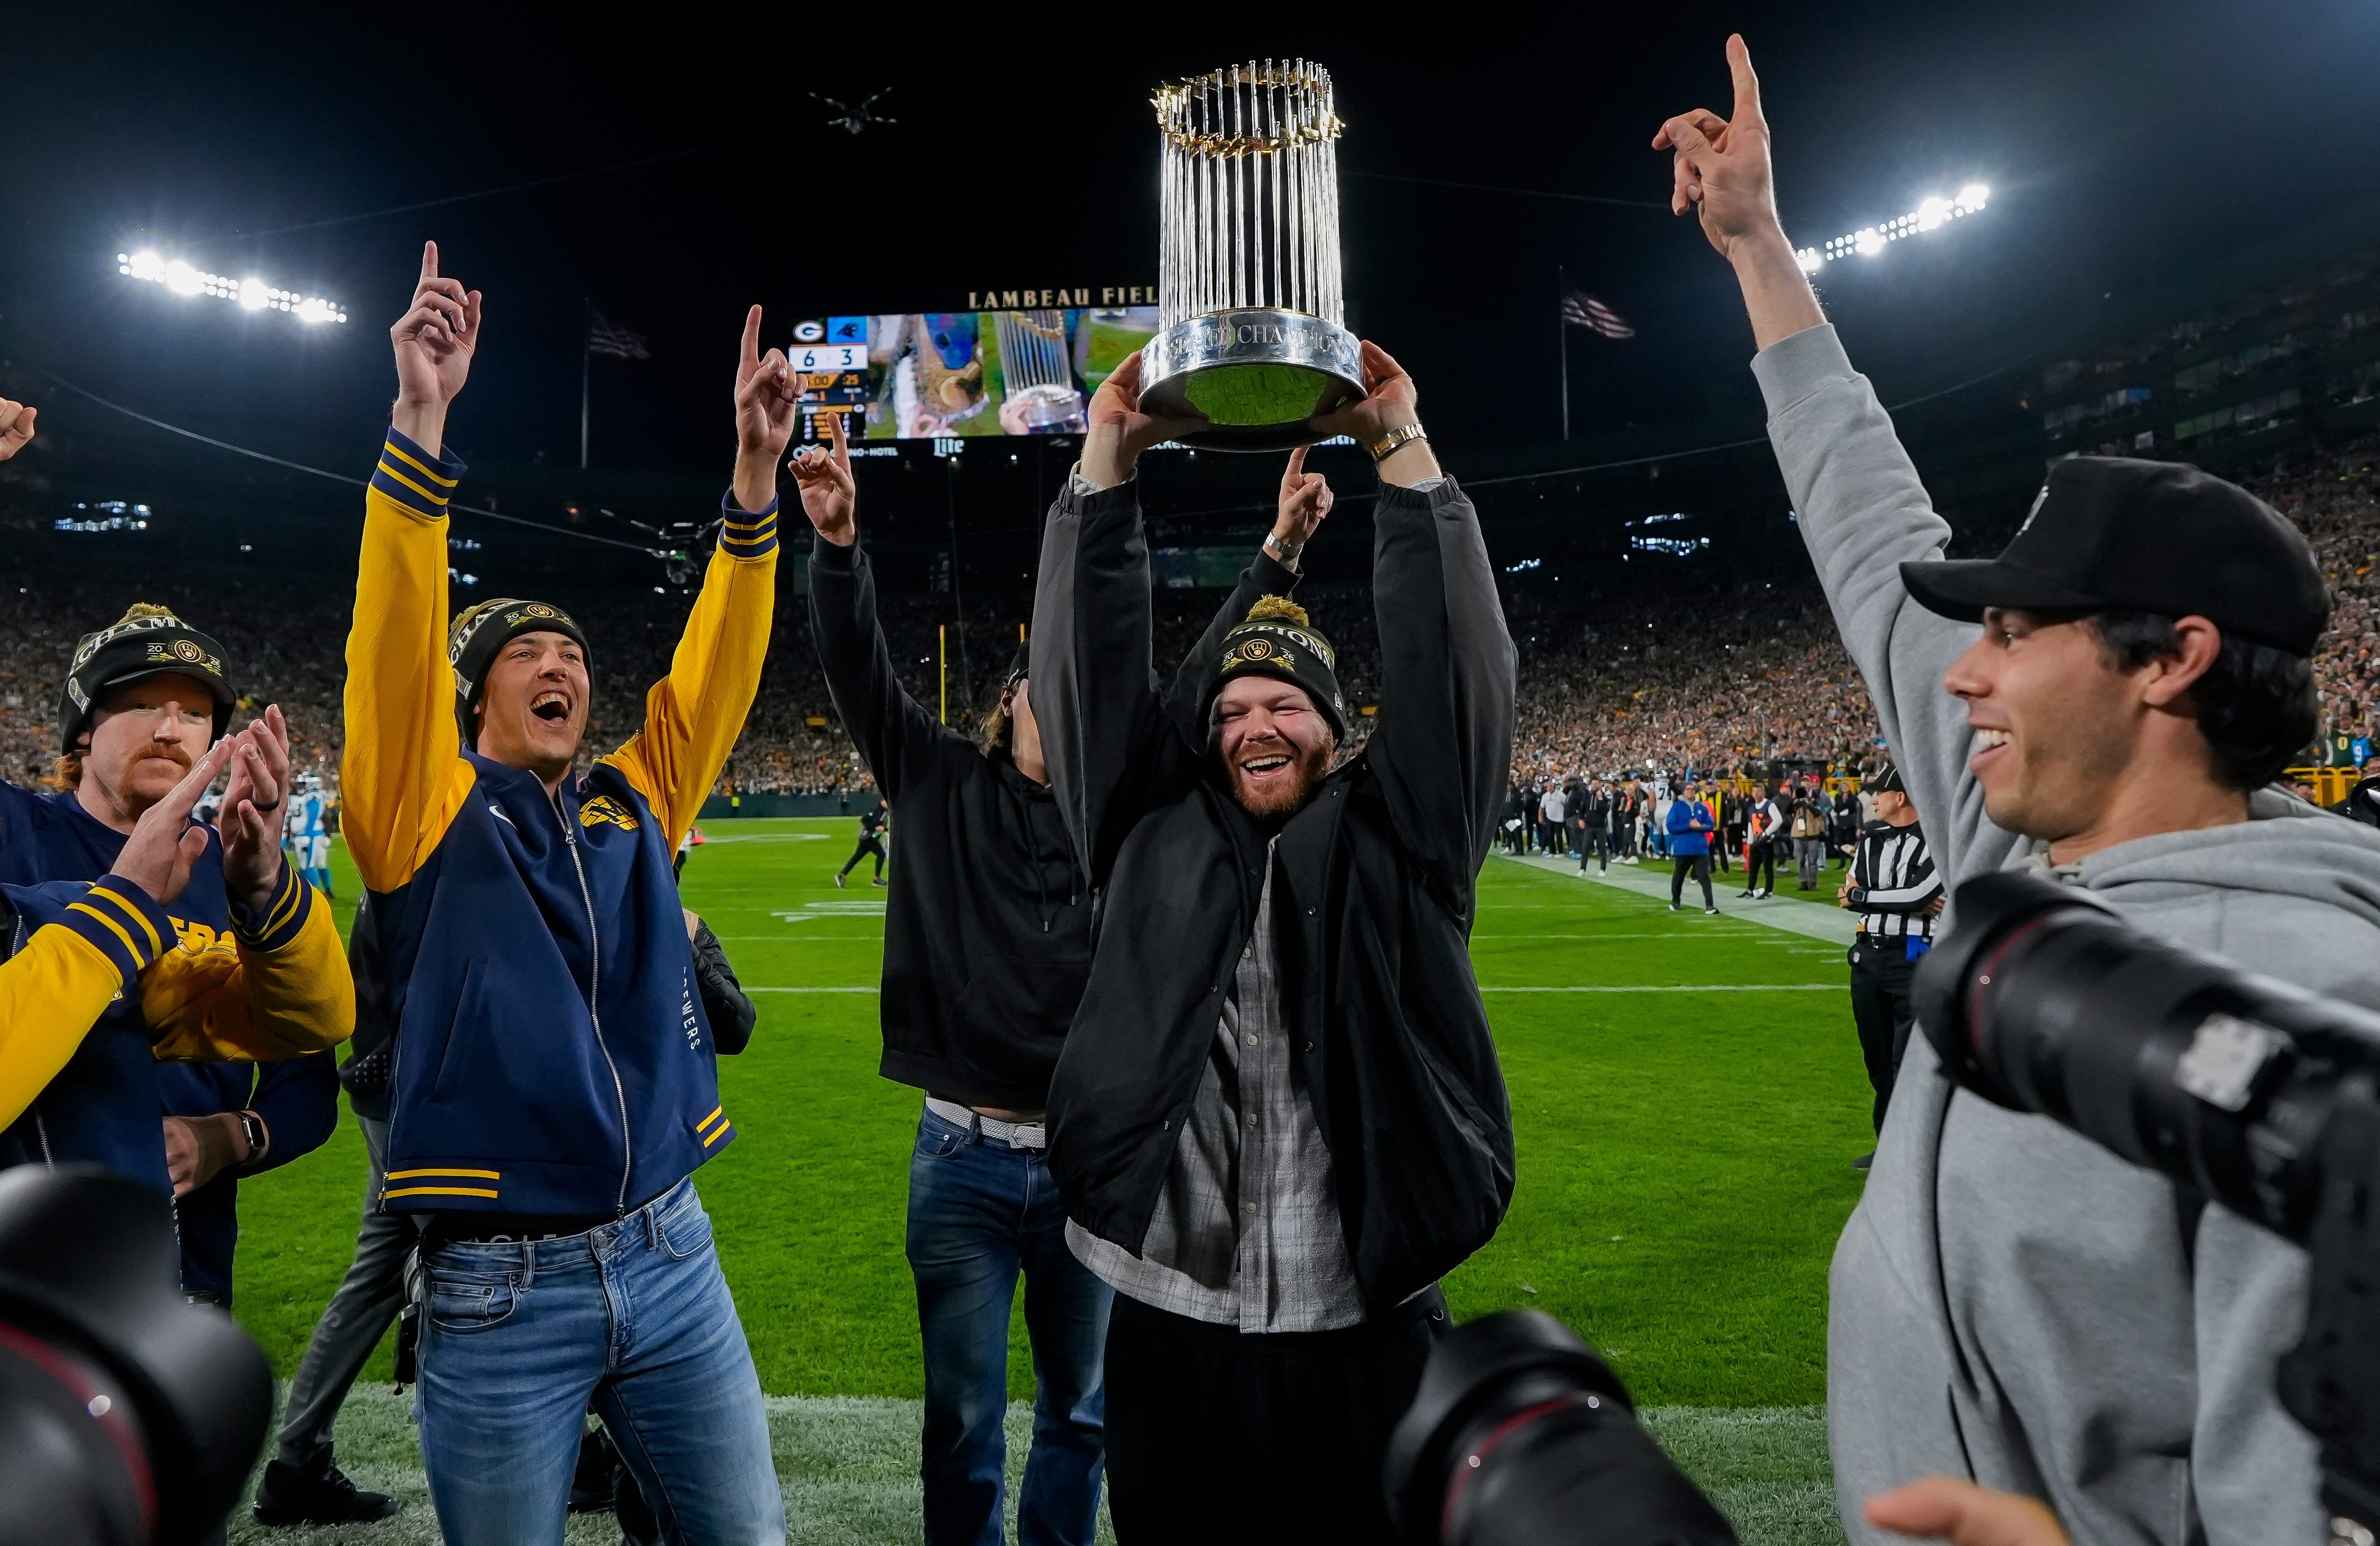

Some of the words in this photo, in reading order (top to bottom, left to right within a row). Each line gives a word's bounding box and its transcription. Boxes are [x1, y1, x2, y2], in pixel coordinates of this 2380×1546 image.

[969, 288, 1089, 310] LAMBEAU
[1102, 286, 1158, 305] FIEL
[804, 350, 814, 367] 6
[841, 349, 852, 365] 3
[869, 447, 899, 457] HOTEL
[933, 438, 965, 458] Lite
[506, 613, 519, 621] 20
[209, 657, 221, 668] 26
[1223, 652, 1234, 662] 20
[1282, 650, 1294, 661] 26
[682, 966, 701, 1050] EWERS
